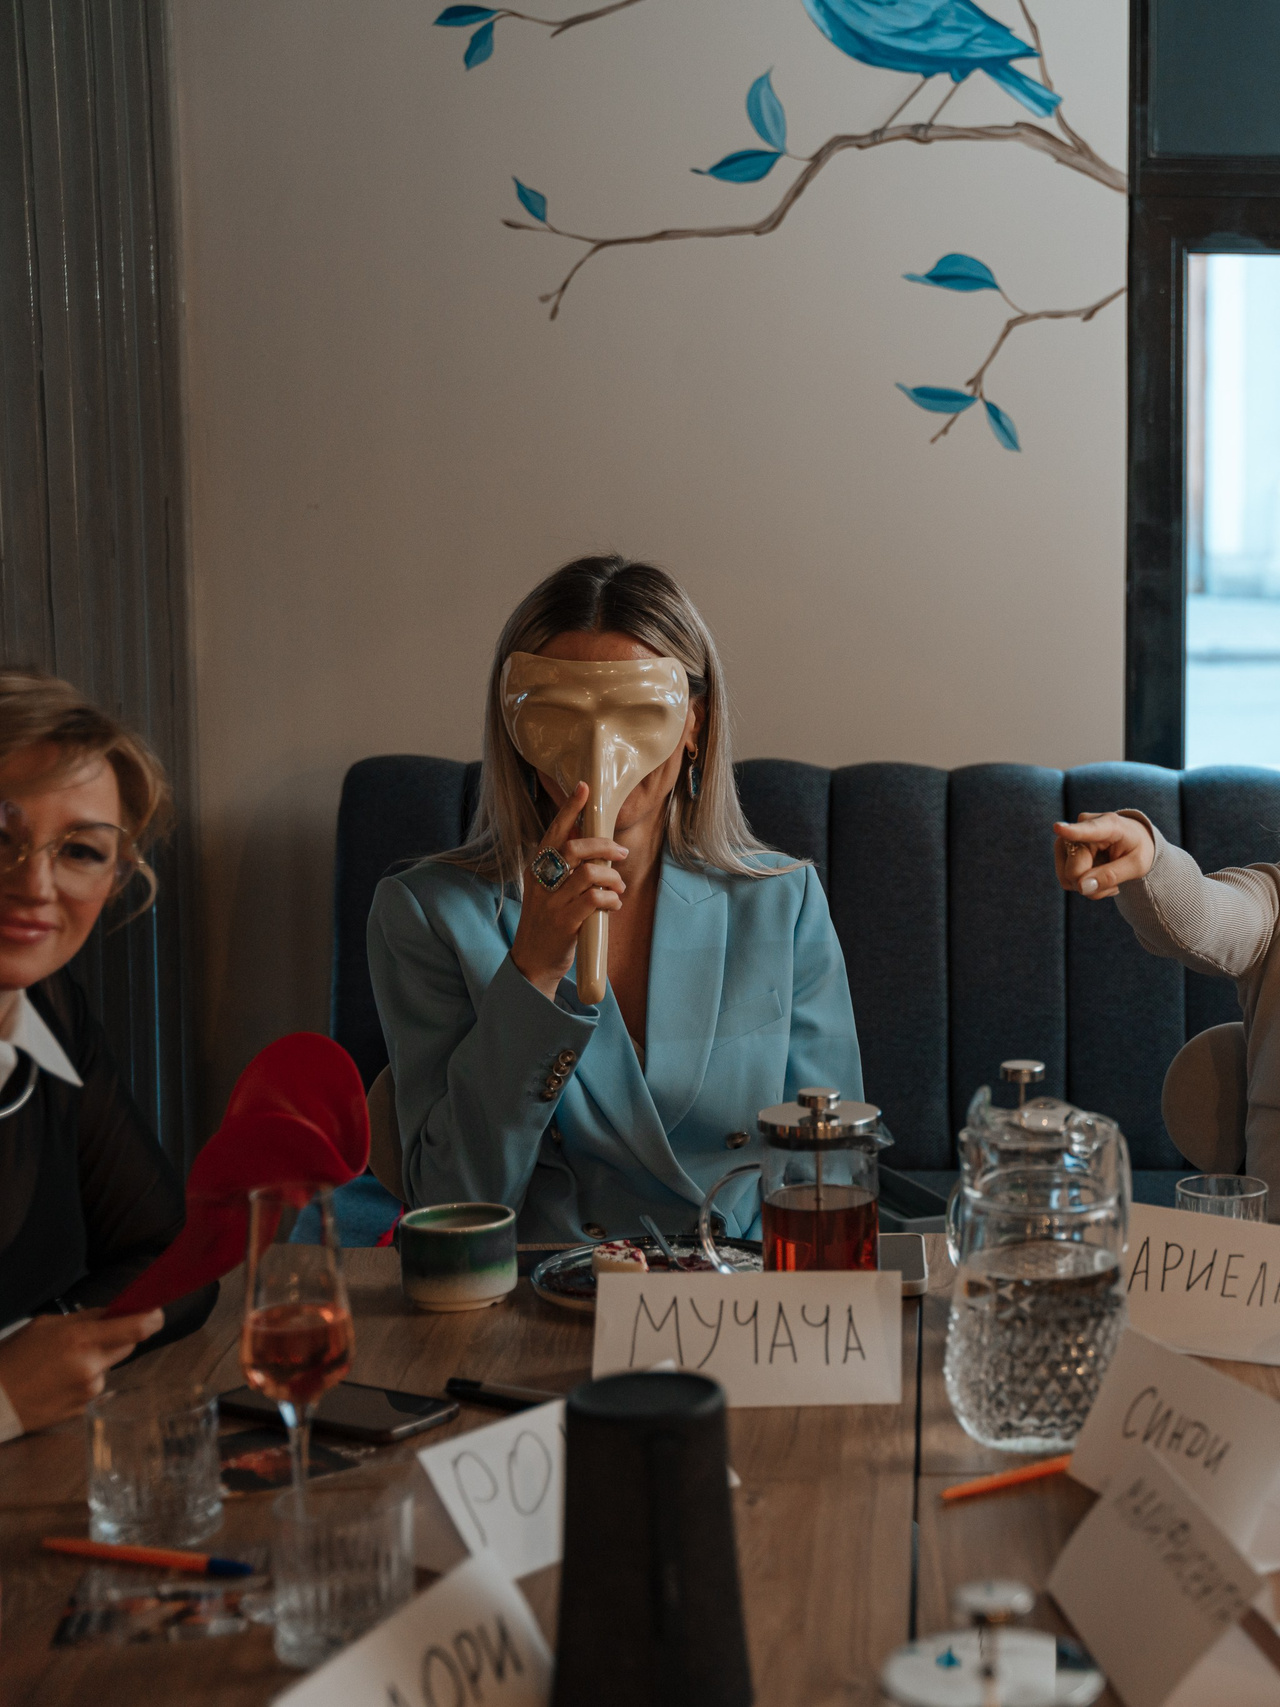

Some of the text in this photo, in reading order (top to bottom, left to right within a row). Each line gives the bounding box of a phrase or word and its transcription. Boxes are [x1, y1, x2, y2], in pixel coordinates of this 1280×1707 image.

[629, 1293, 866, 1369] МУЧАЧА
[452, 1421, 567, 1548] РО
[387, 1611, 525, 1707] ОРИ
